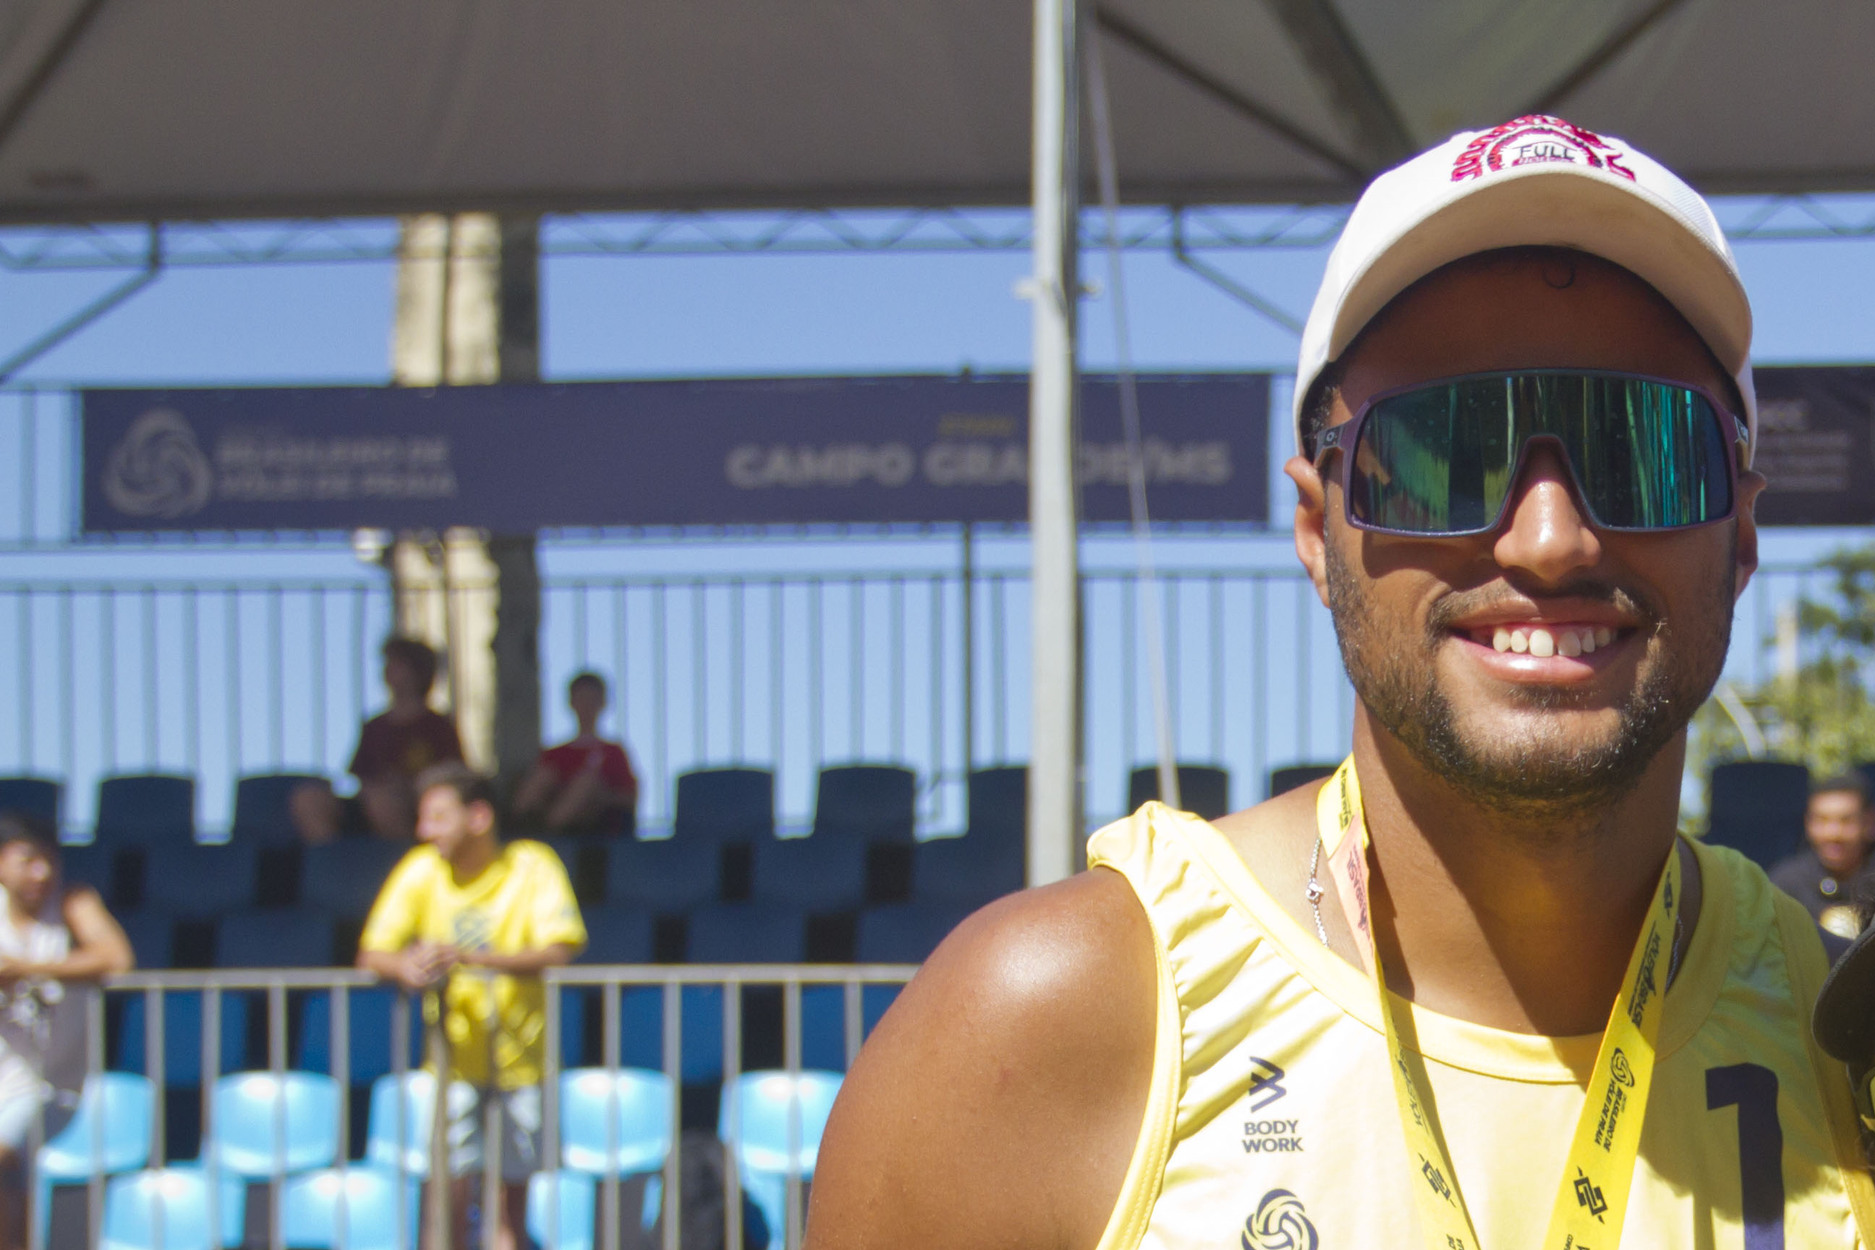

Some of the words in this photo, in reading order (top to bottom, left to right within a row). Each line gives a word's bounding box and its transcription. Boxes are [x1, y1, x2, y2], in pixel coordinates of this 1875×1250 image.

[1520, 144, 1575, 160] FULL
[724, 440, 914, 491] CAMPO
[922, 436, 1233, 489] GRADE/MS
[1244, 1119, 1299, 1136] BODY
[1242, 1137, 1304, 1153] WORK
